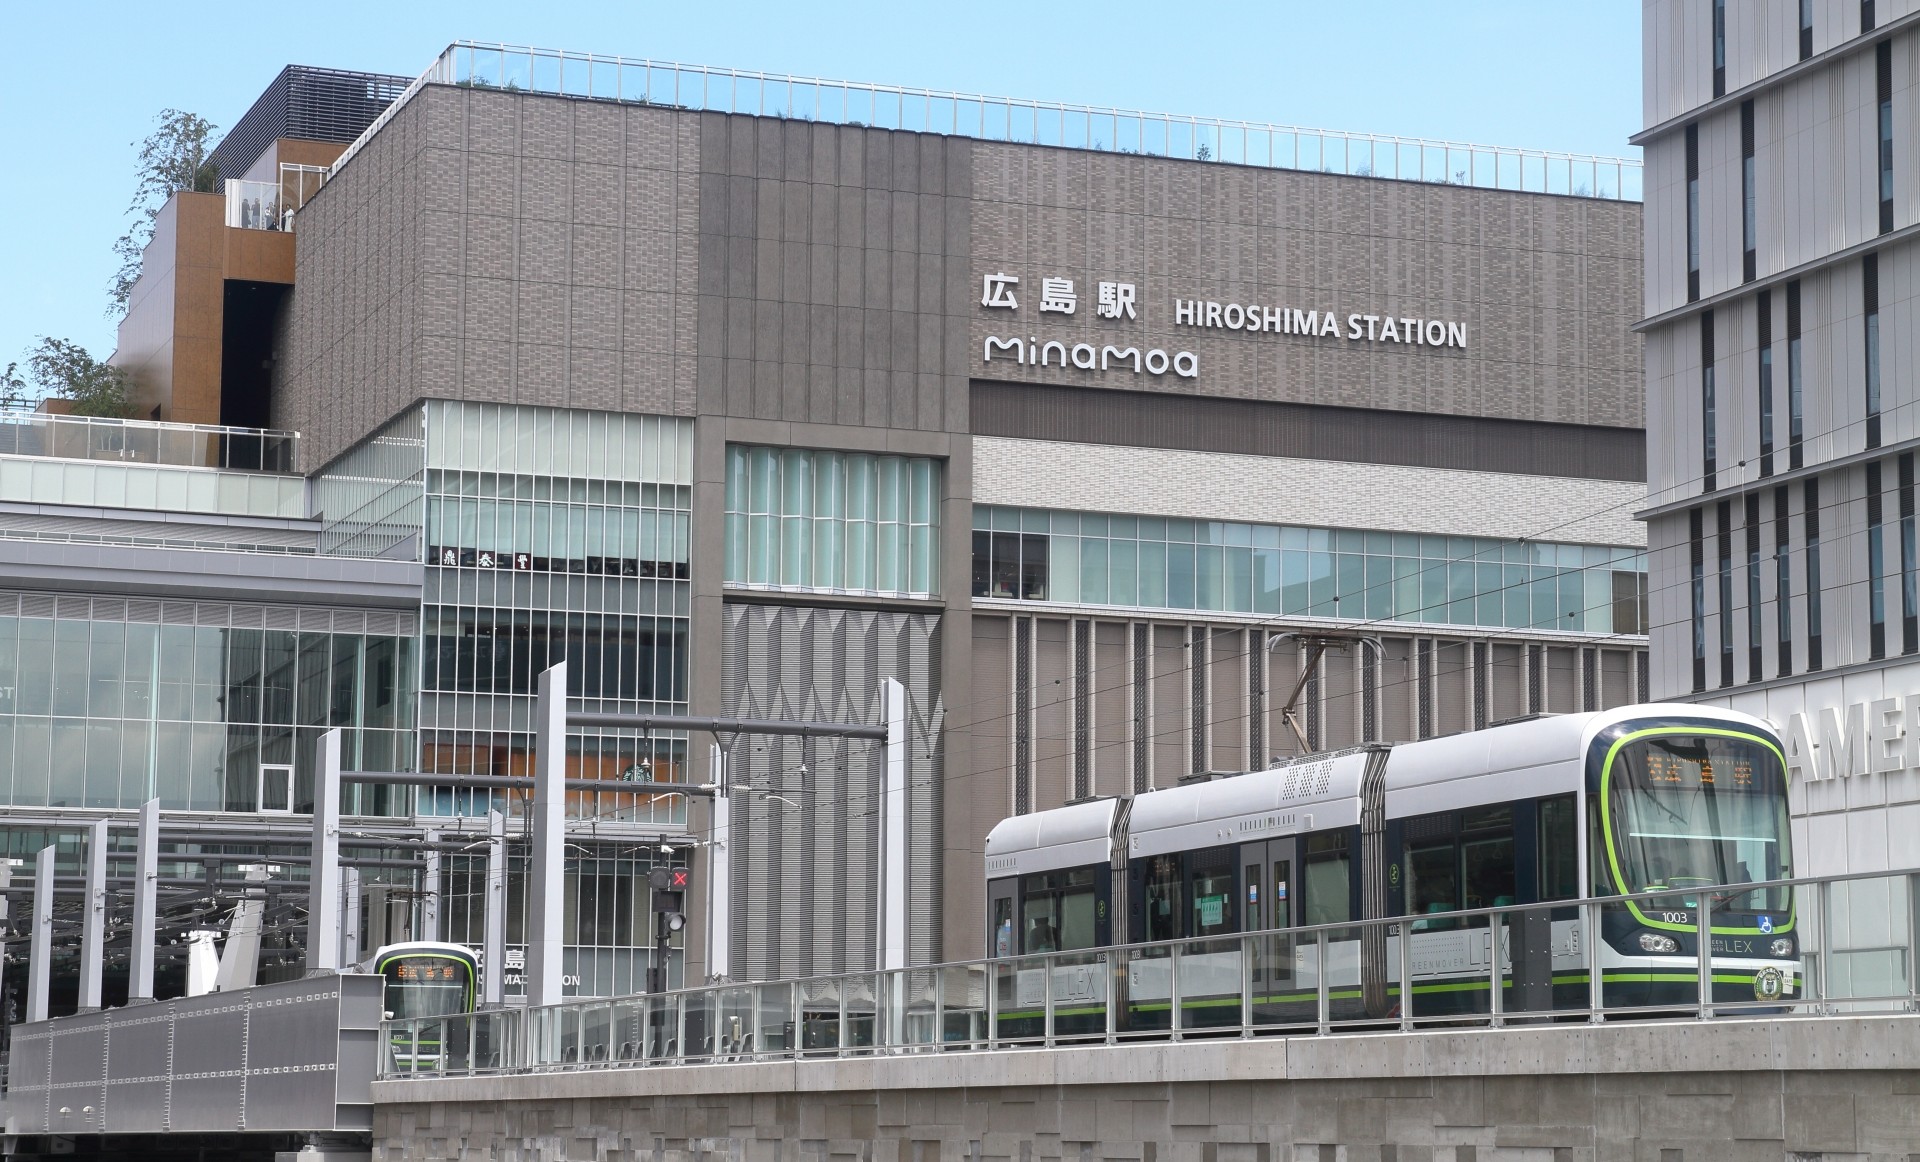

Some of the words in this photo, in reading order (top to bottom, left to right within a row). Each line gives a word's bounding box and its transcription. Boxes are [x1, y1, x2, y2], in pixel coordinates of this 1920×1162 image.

[980, 271, 1137, 320] 広島駅
[1175, 299, 1341, 338] HIROSHIMA
[1348, 313, 1467, 349] STATION
[1662, 912, 1688, 923] 1003
[1724, 939, 1753, 953] LEX
[1411, 958, 1464, 970] REENMOVER
[1067, 967, 1095, 995] LEX
